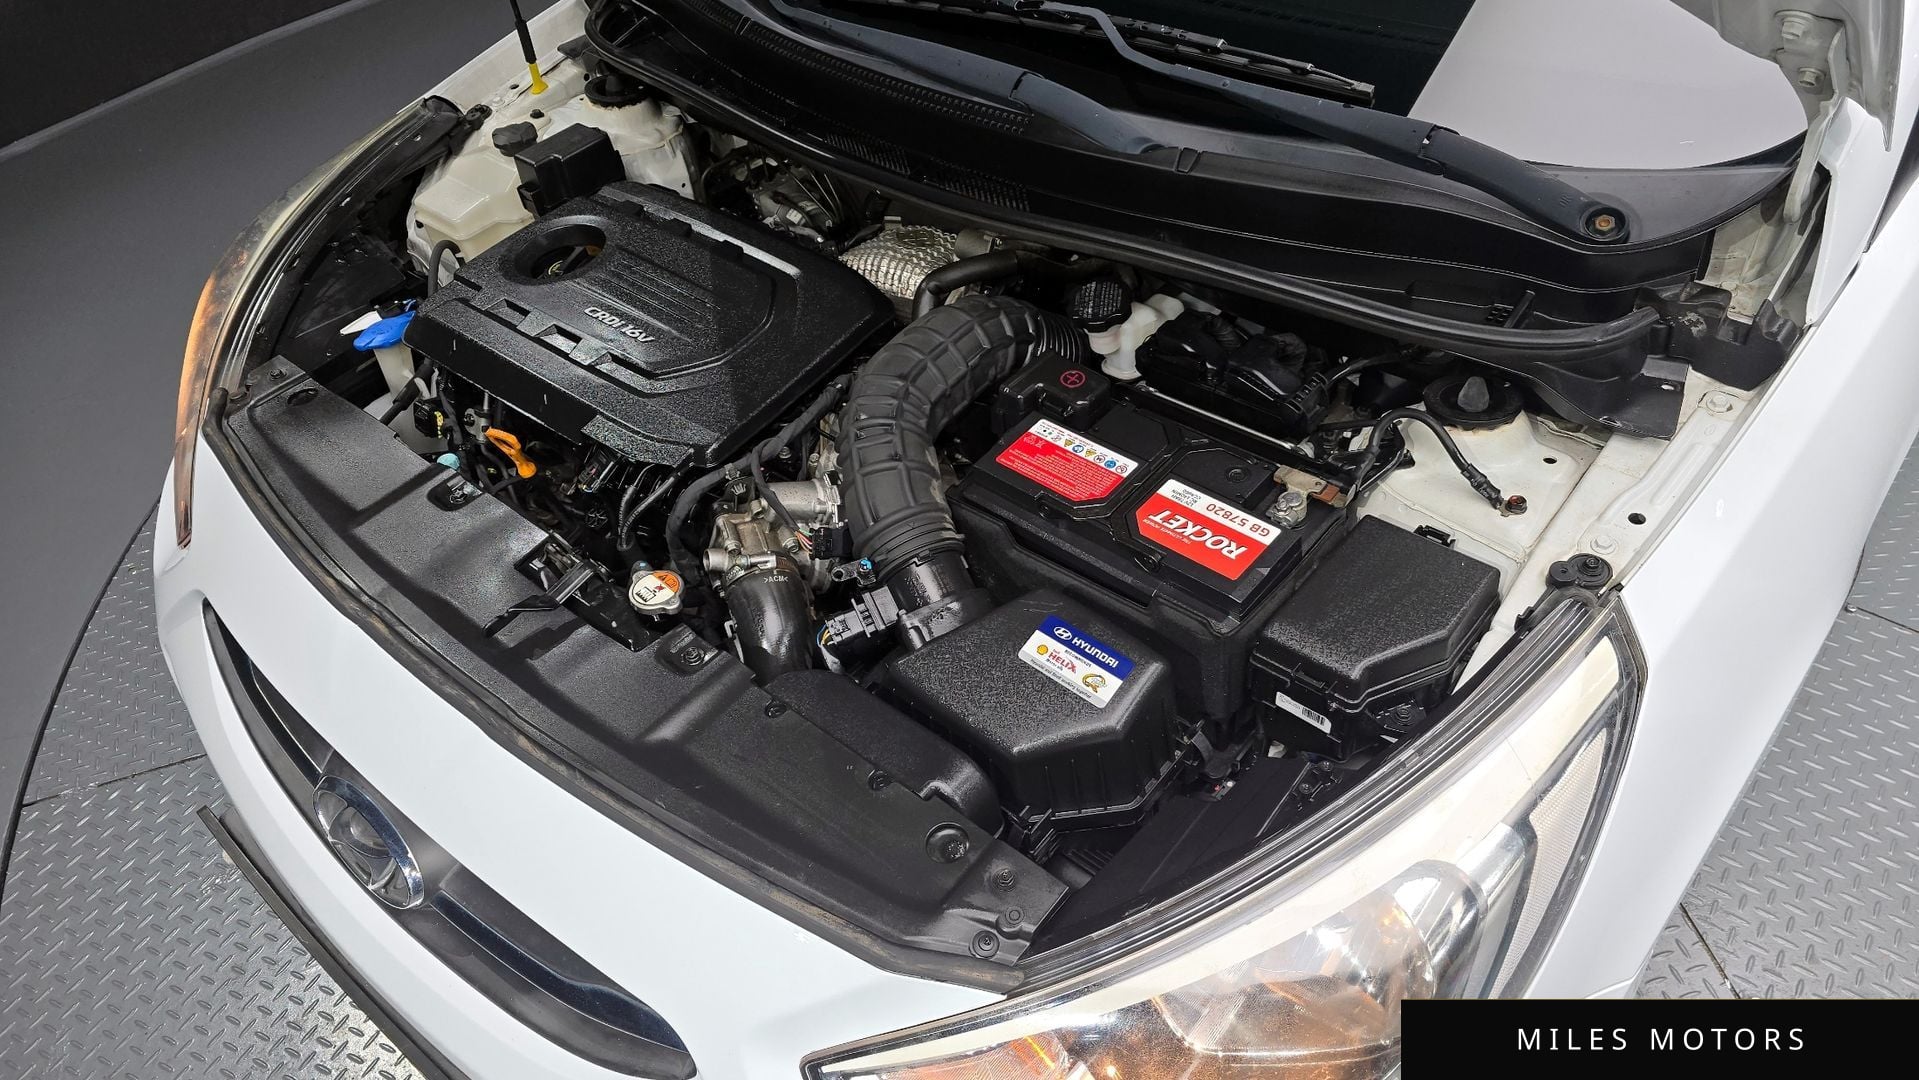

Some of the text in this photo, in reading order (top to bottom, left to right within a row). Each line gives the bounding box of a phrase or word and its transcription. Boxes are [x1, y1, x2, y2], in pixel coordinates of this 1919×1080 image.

[621, 324, 655, 342] 16V
[1148, 510, 1248, 560] ROCKET
[1206, 503, 1271, 537] GB 57820
[1048, 652, 1076, 673] HELIX
[1072, 637, 1119, 668] HYUNDAI
